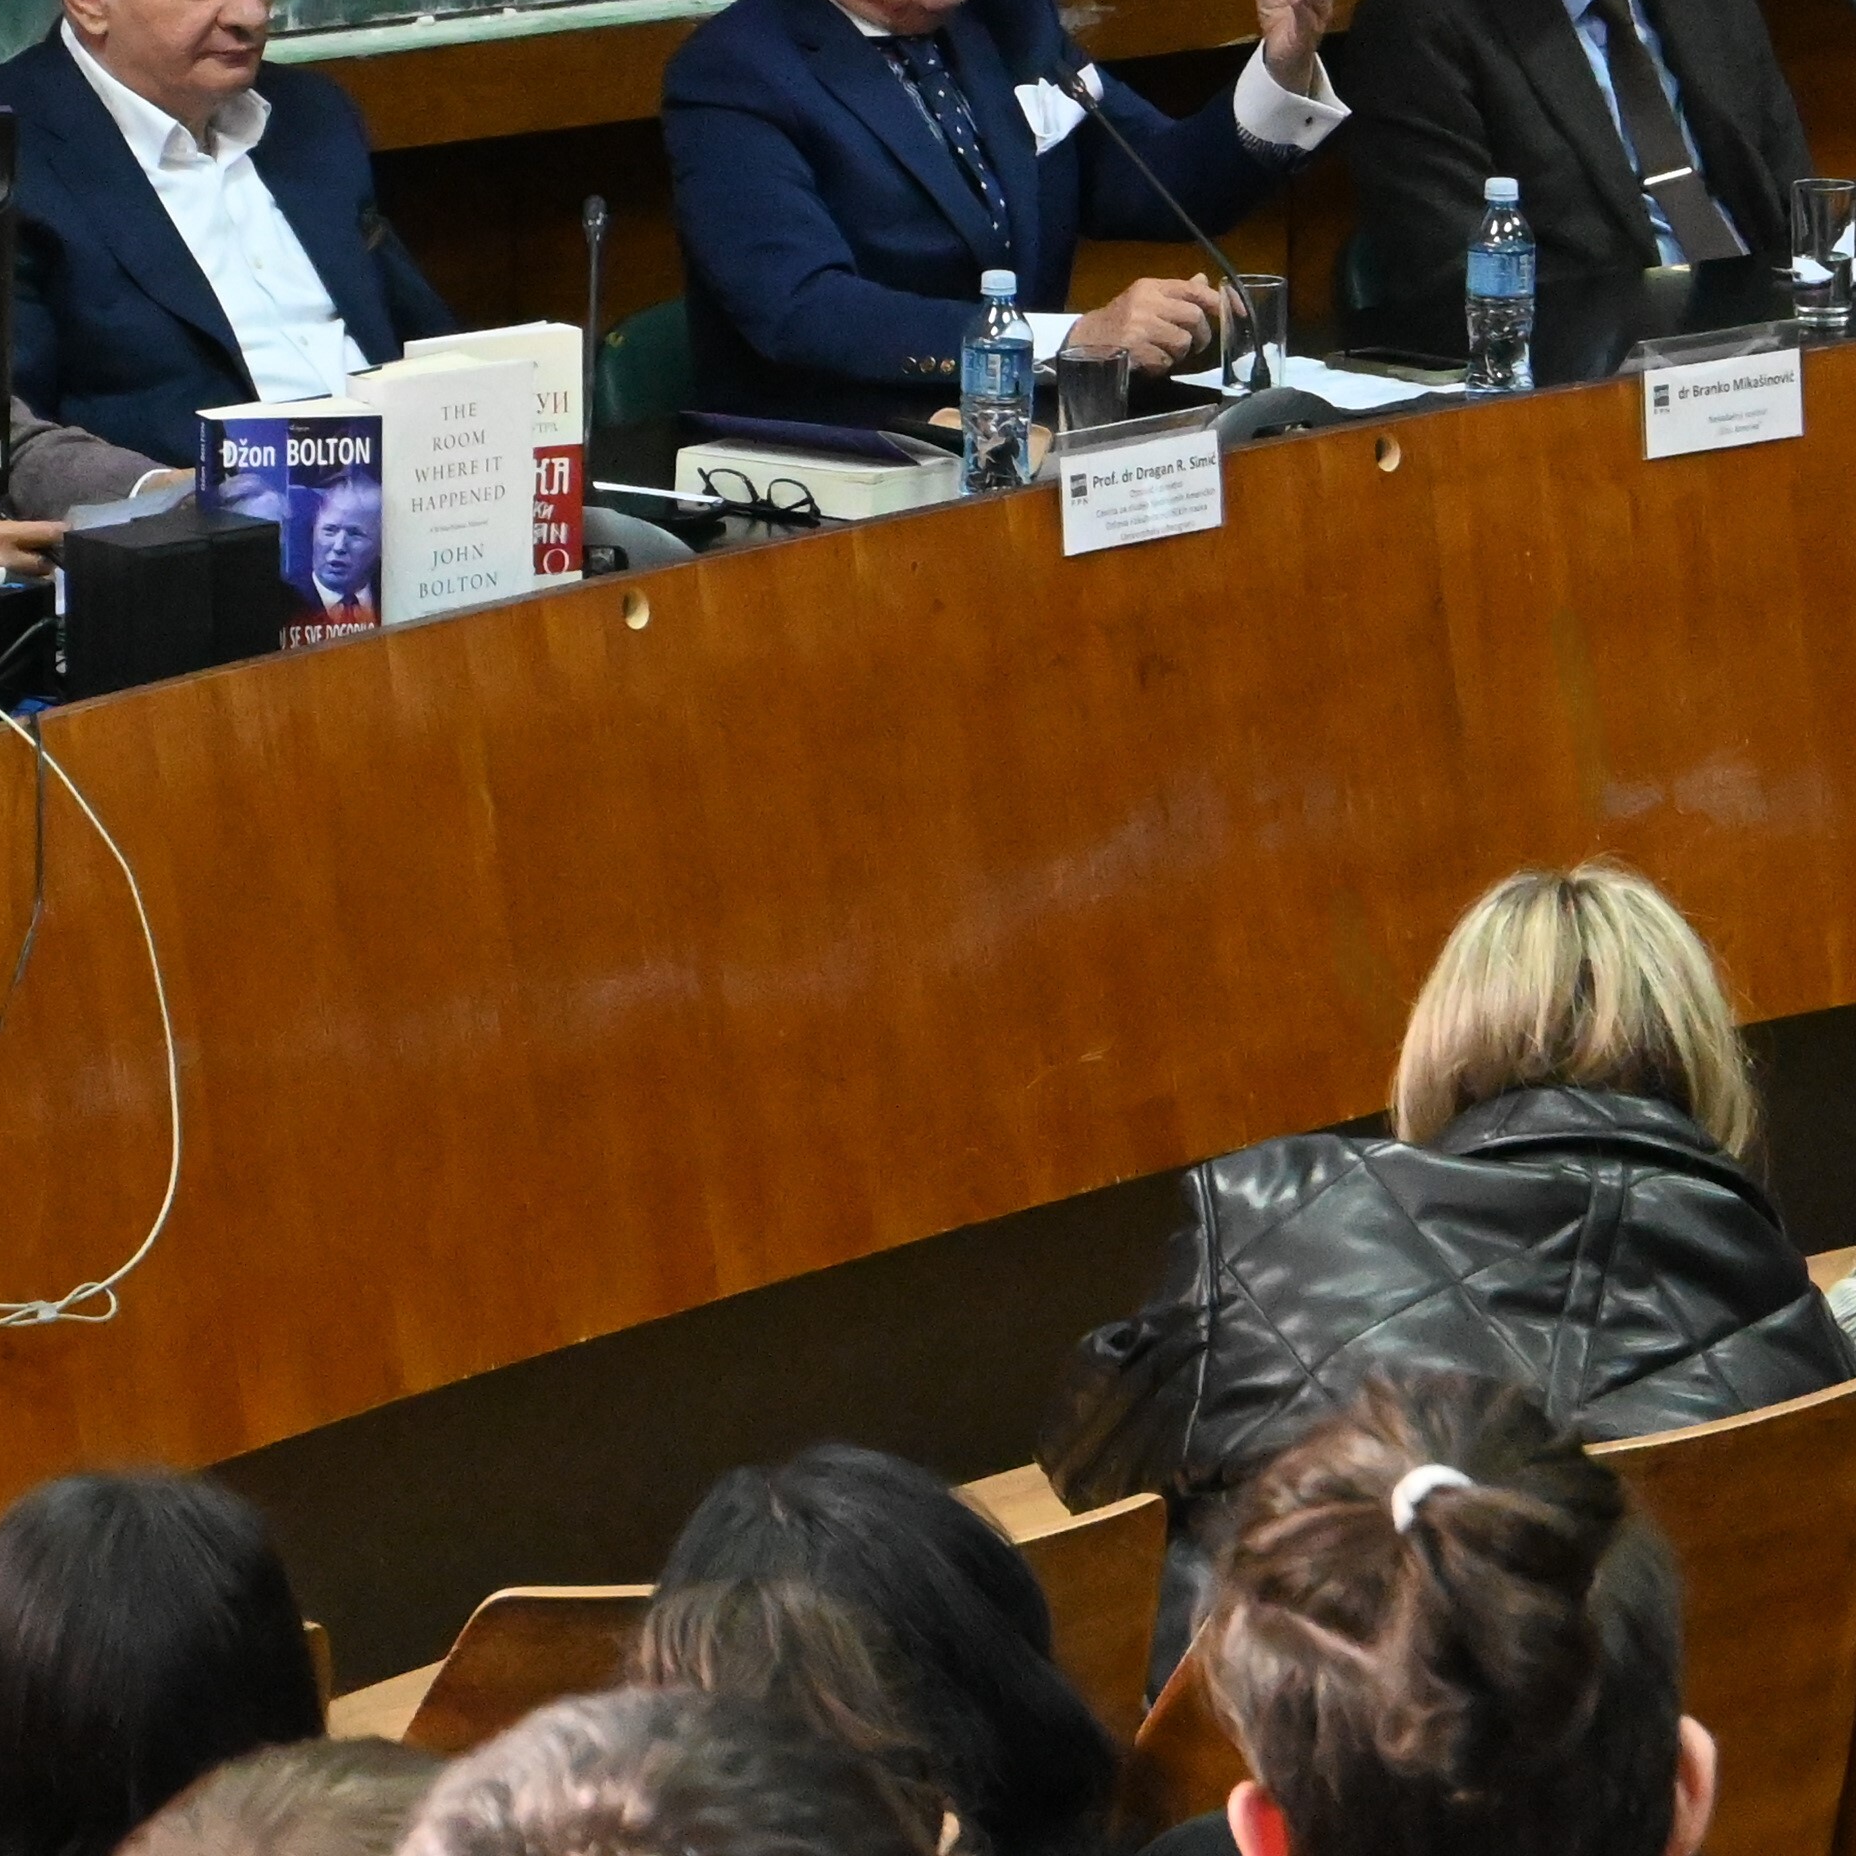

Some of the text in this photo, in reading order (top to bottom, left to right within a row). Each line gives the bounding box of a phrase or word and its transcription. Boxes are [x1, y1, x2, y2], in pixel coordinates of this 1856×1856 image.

[1678, 371, 1795, 400] dr Branko Mikašinović
[442, 402, 477, 421] THE
[223, 437, 371, 468] Džon BOLTON
[433, 429, 485, 451] ROOM
[415, 456, 502, 483] WHERE IT
[1093, 452, 1216, 488] Prof. dr Dragan R. Simić
[412, 484, 506, 512] HAPPENED
[431, 544, 484, 571] JOHN
[419, 571, 498, 598] BOLTON
